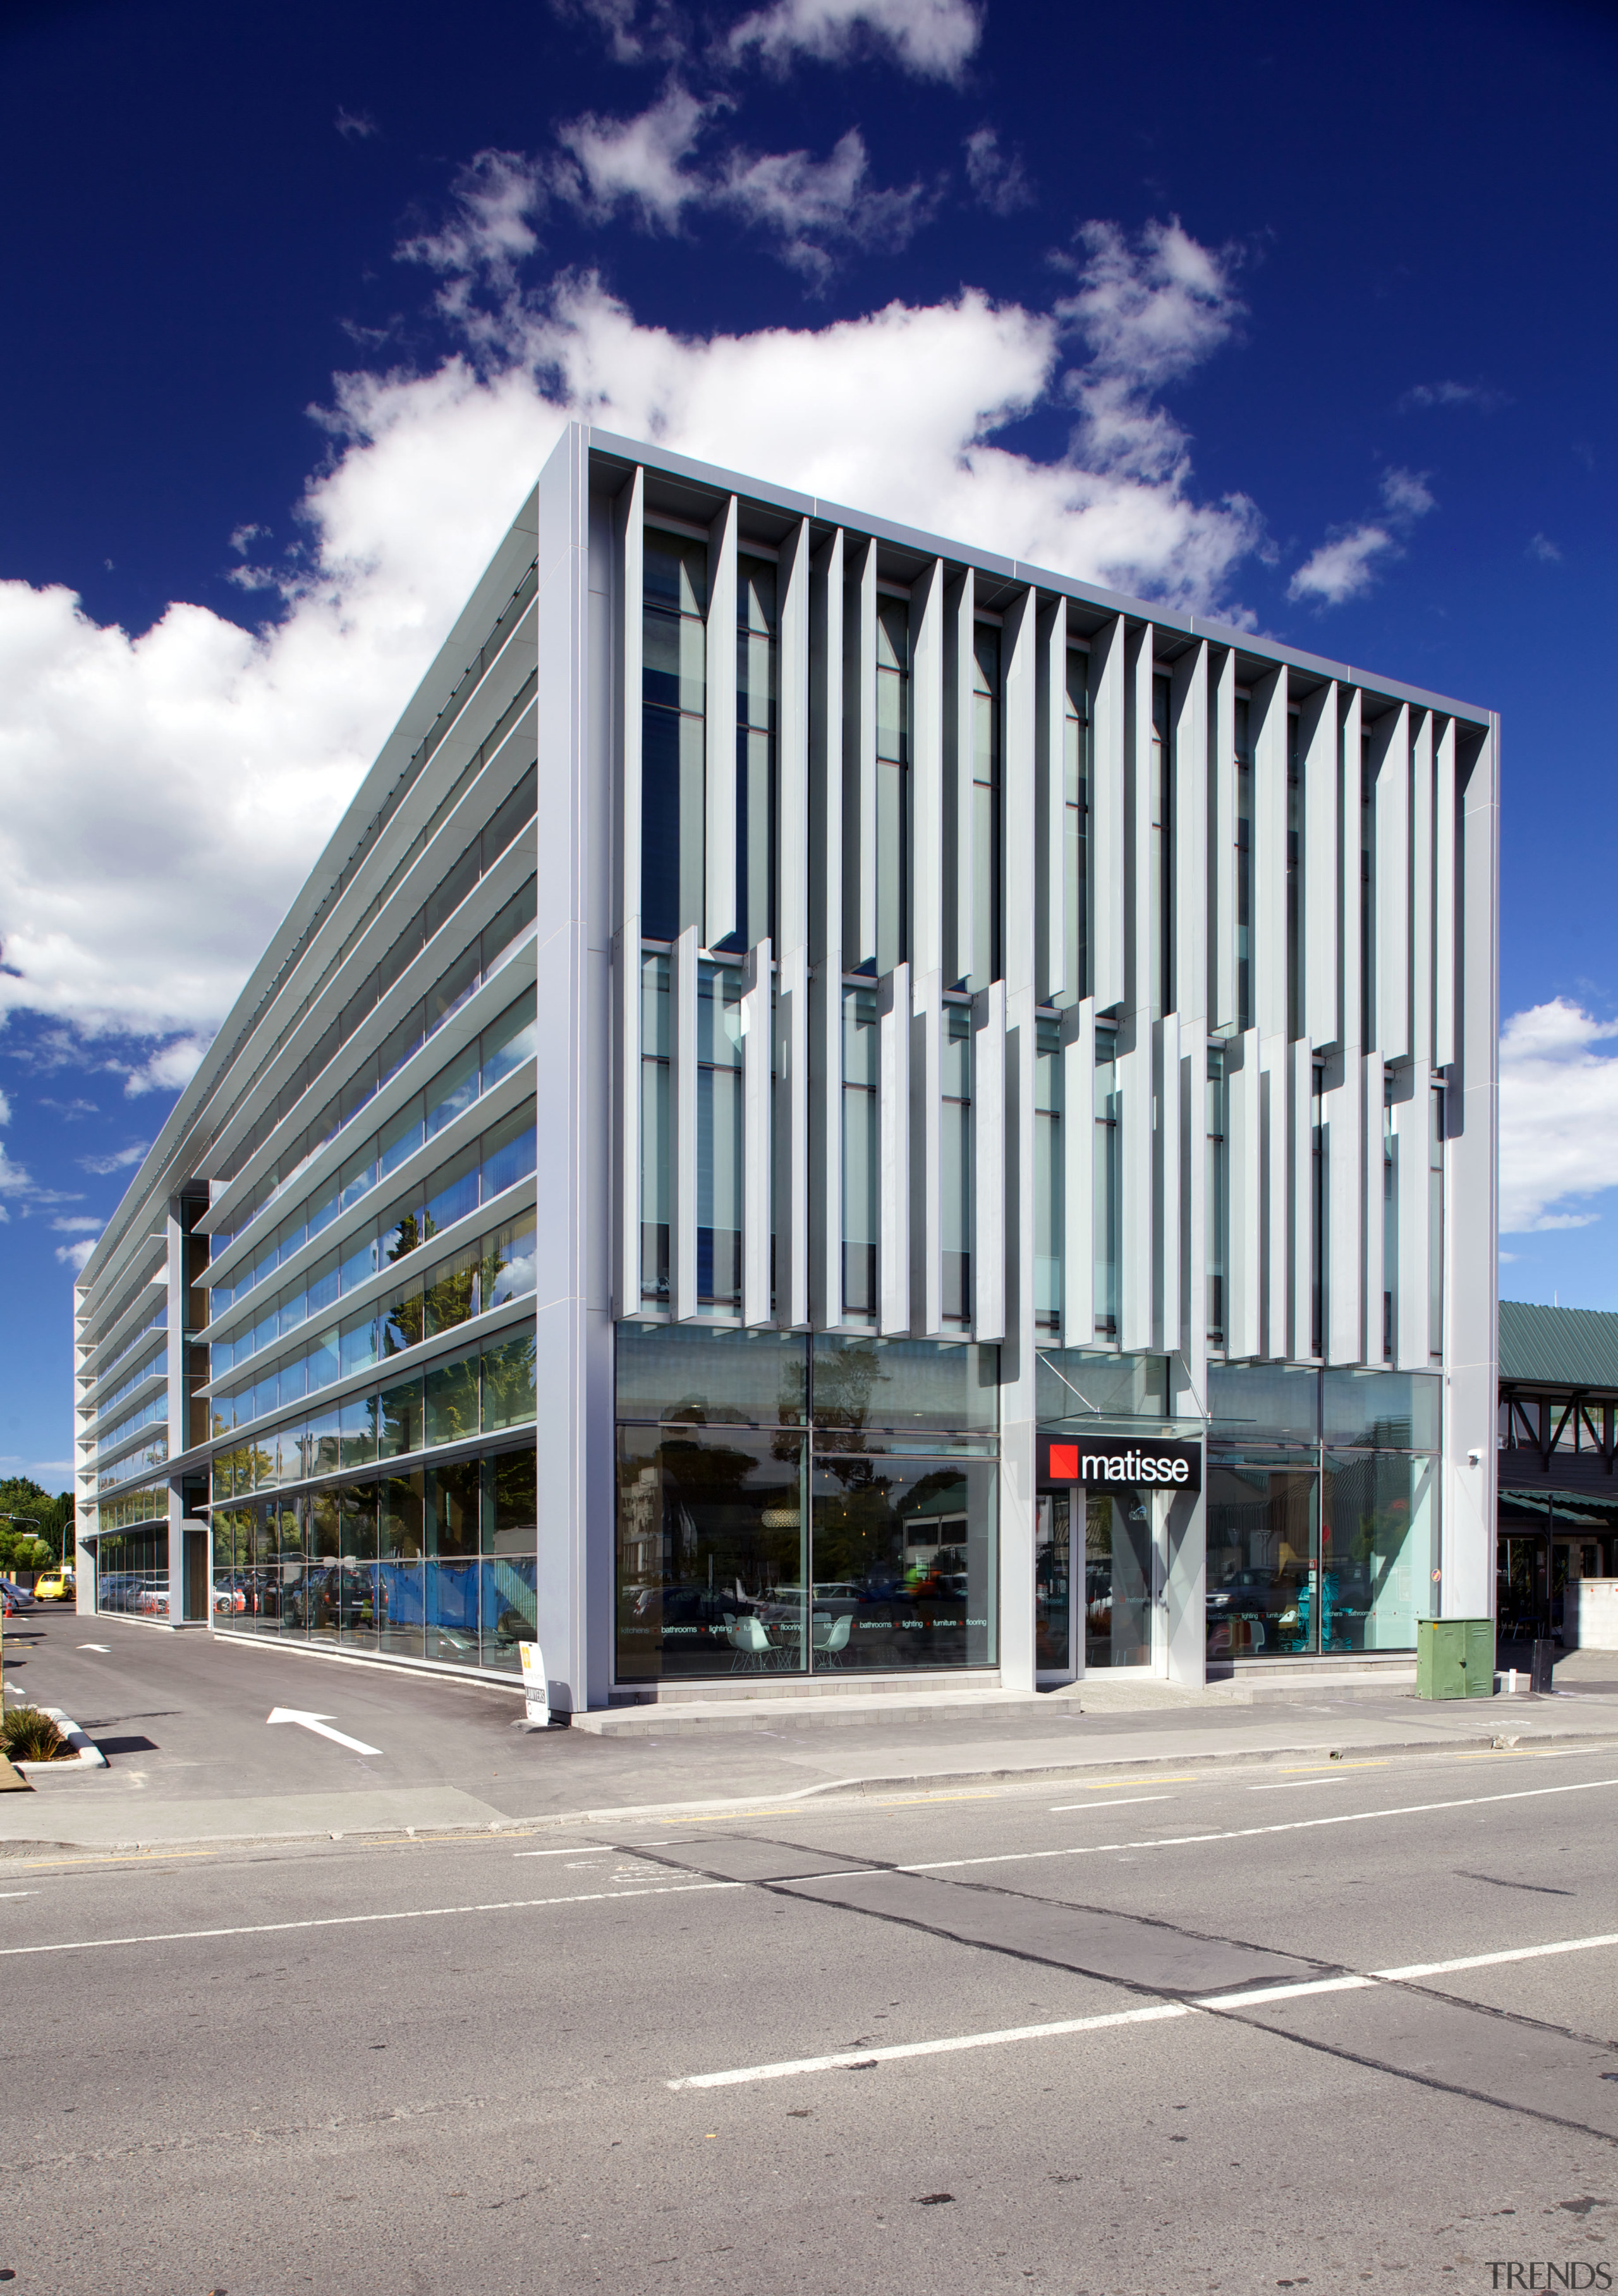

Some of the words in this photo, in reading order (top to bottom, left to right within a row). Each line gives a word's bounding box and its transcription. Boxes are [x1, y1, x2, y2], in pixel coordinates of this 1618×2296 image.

[1082, 1449, 1189, 1482] matisse
[709, 1625, 732, 1633] lighting
[781, 1623, 803, 1631] flooring
[903, 1620, 923, 1628] lighting
[526, 1687, 545, 1701] LAWYERS
